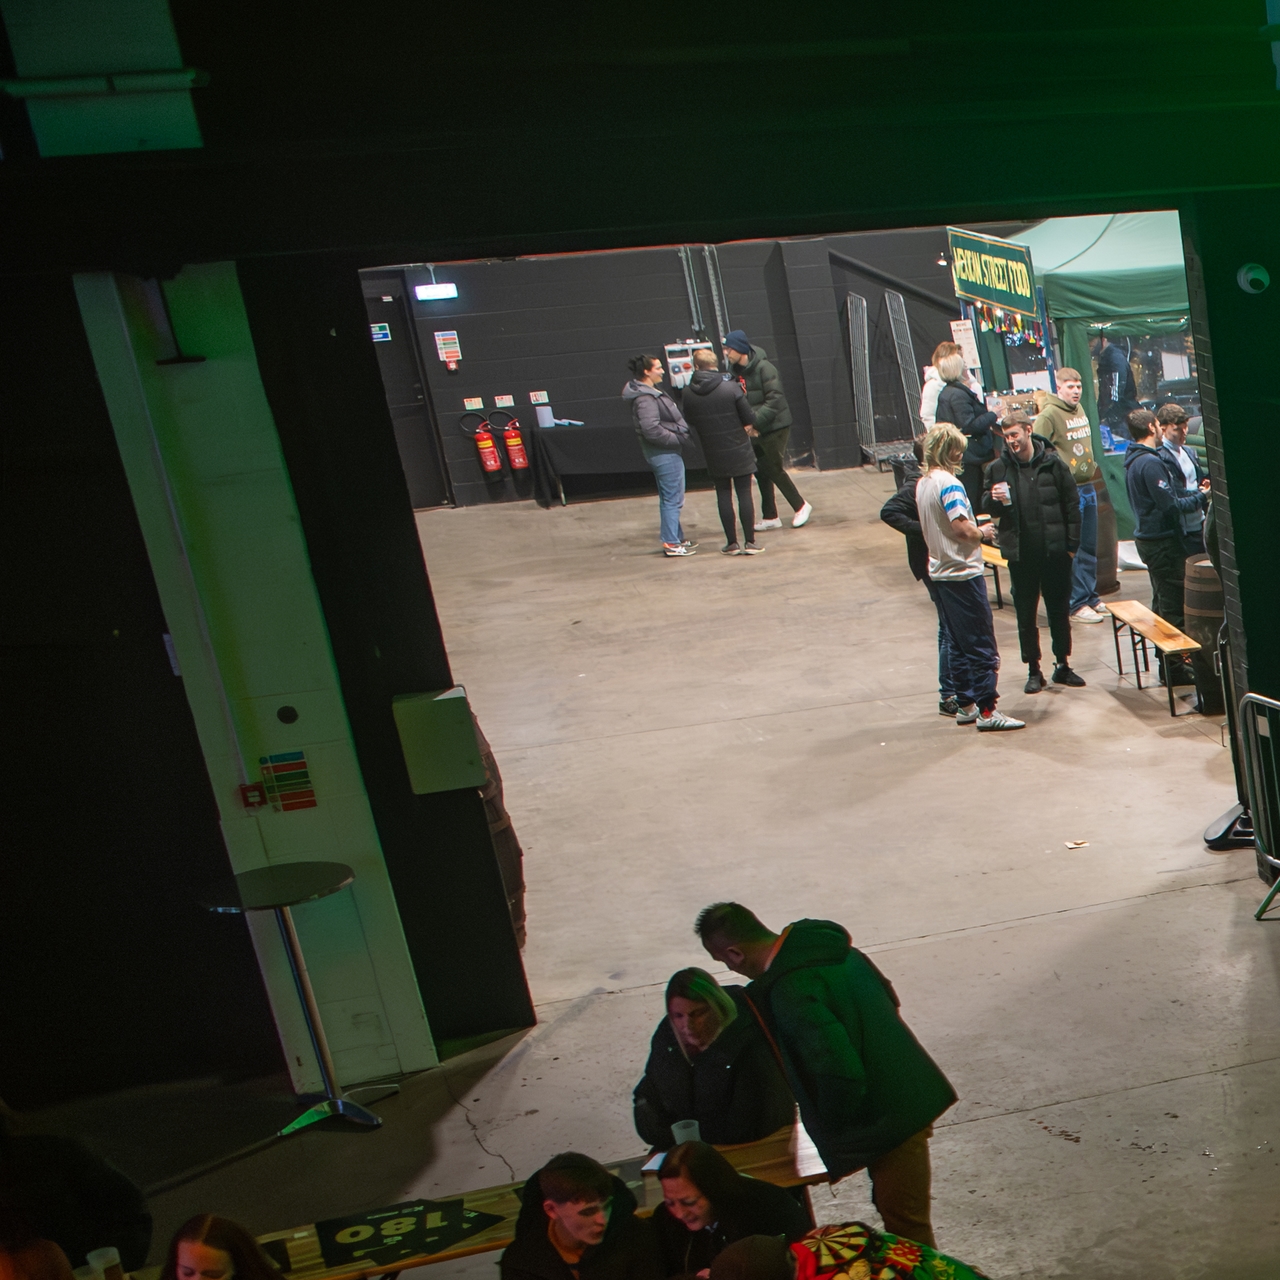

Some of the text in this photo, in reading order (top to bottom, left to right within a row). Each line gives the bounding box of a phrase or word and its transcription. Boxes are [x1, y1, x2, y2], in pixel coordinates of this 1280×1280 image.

[981, 254, 1009, 293] STREET
[1007, 259, 1031, 298] FOOD
[335, 1211, 448, 1244] 180
